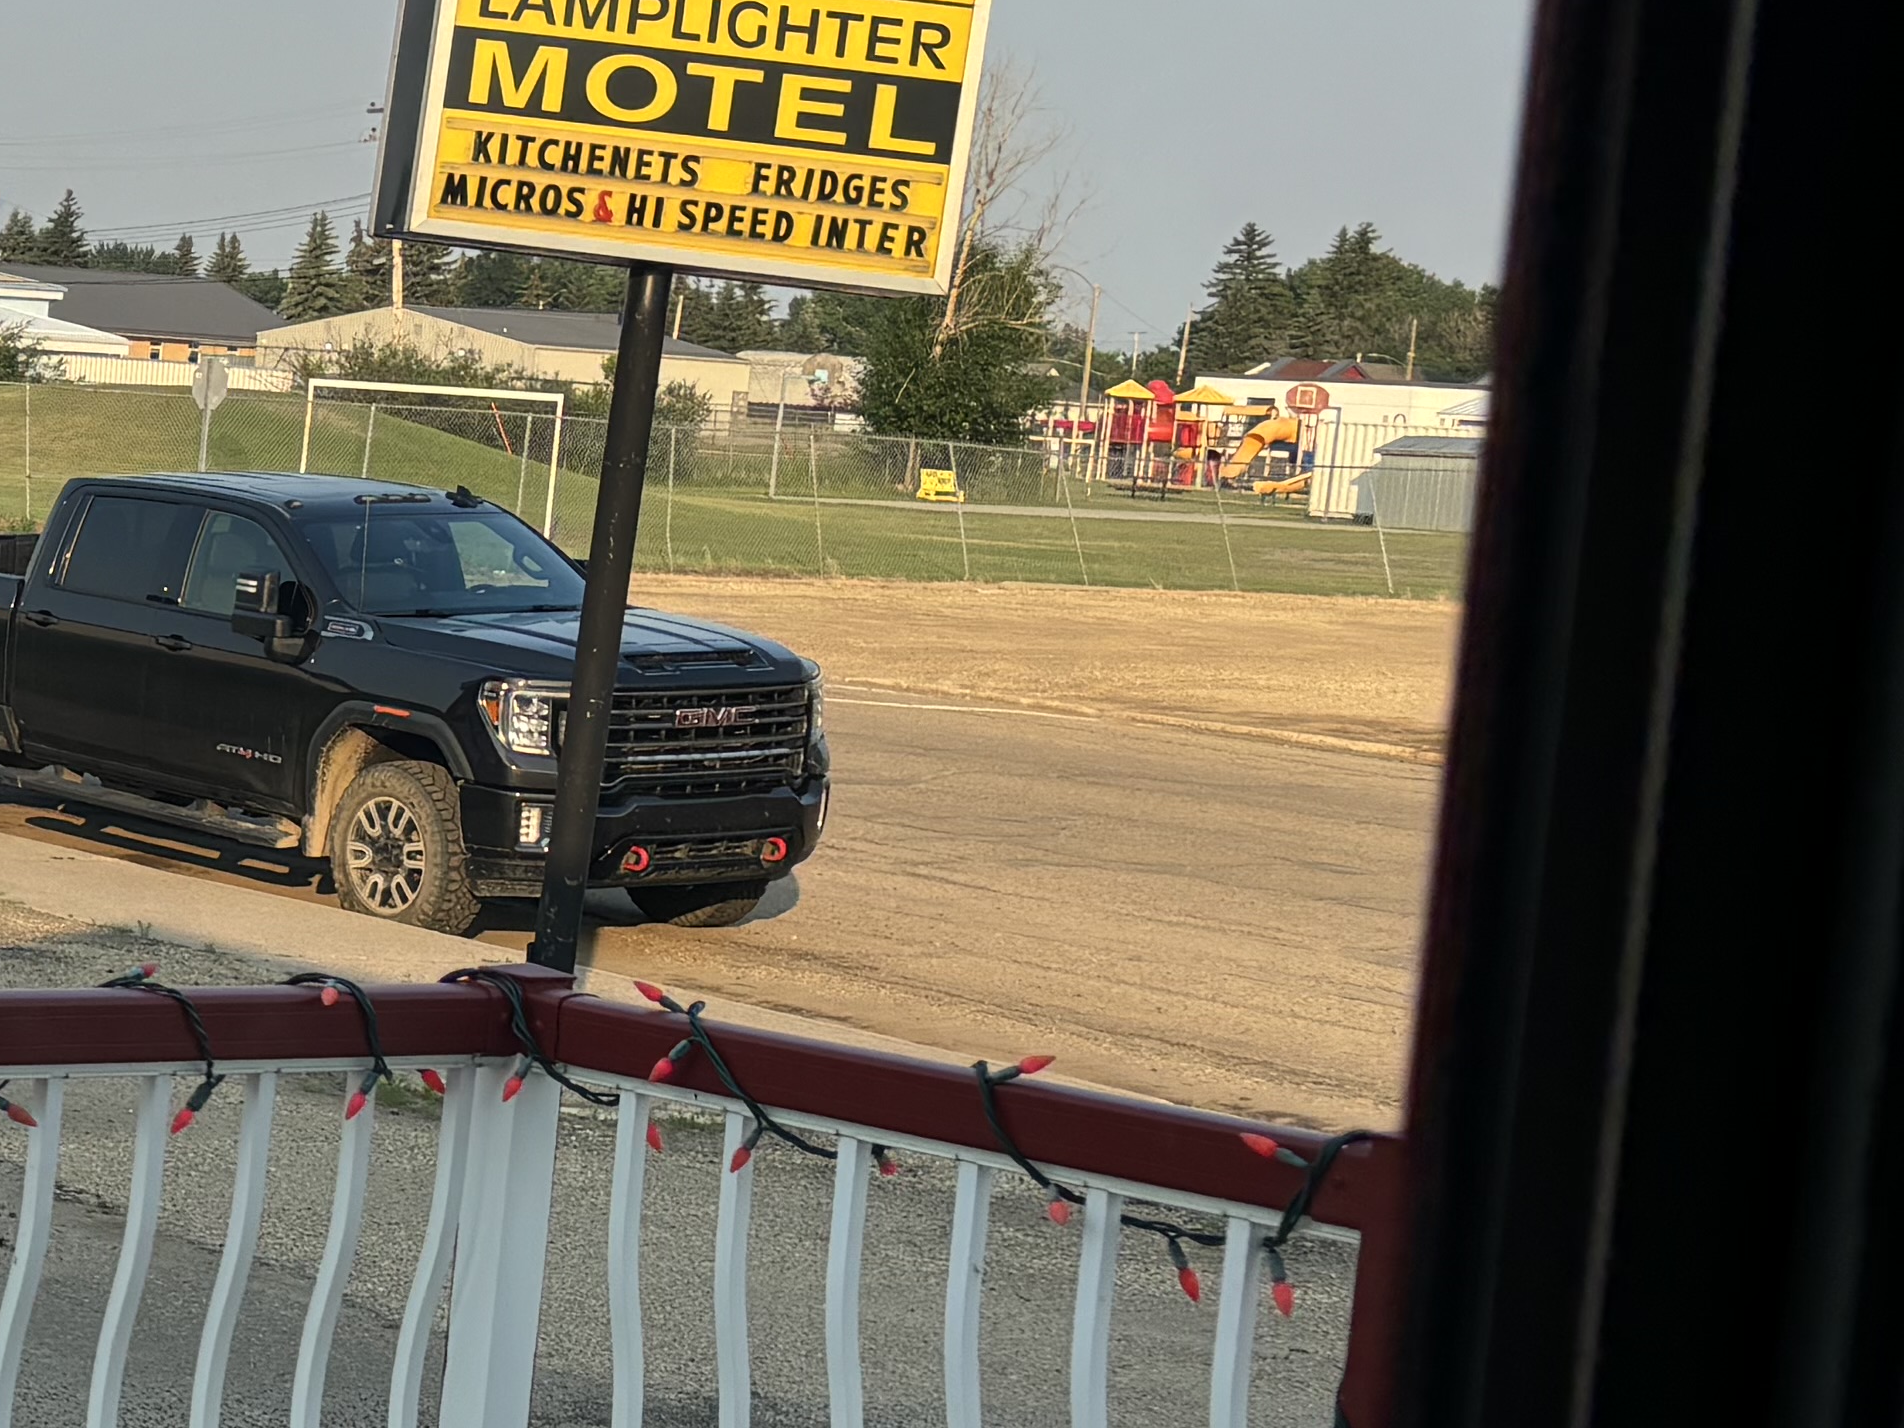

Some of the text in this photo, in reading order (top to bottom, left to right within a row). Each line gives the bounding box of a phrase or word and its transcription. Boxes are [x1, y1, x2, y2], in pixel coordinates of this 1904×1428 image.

[466, 38, 937, 156] MOTEL
[471, 130, 911, 212] KITCHENETS FRIDGES
[440, 172, 928, 258] MICROS & HI SPEED INTER
[675, 705, 760, 728] GMC
